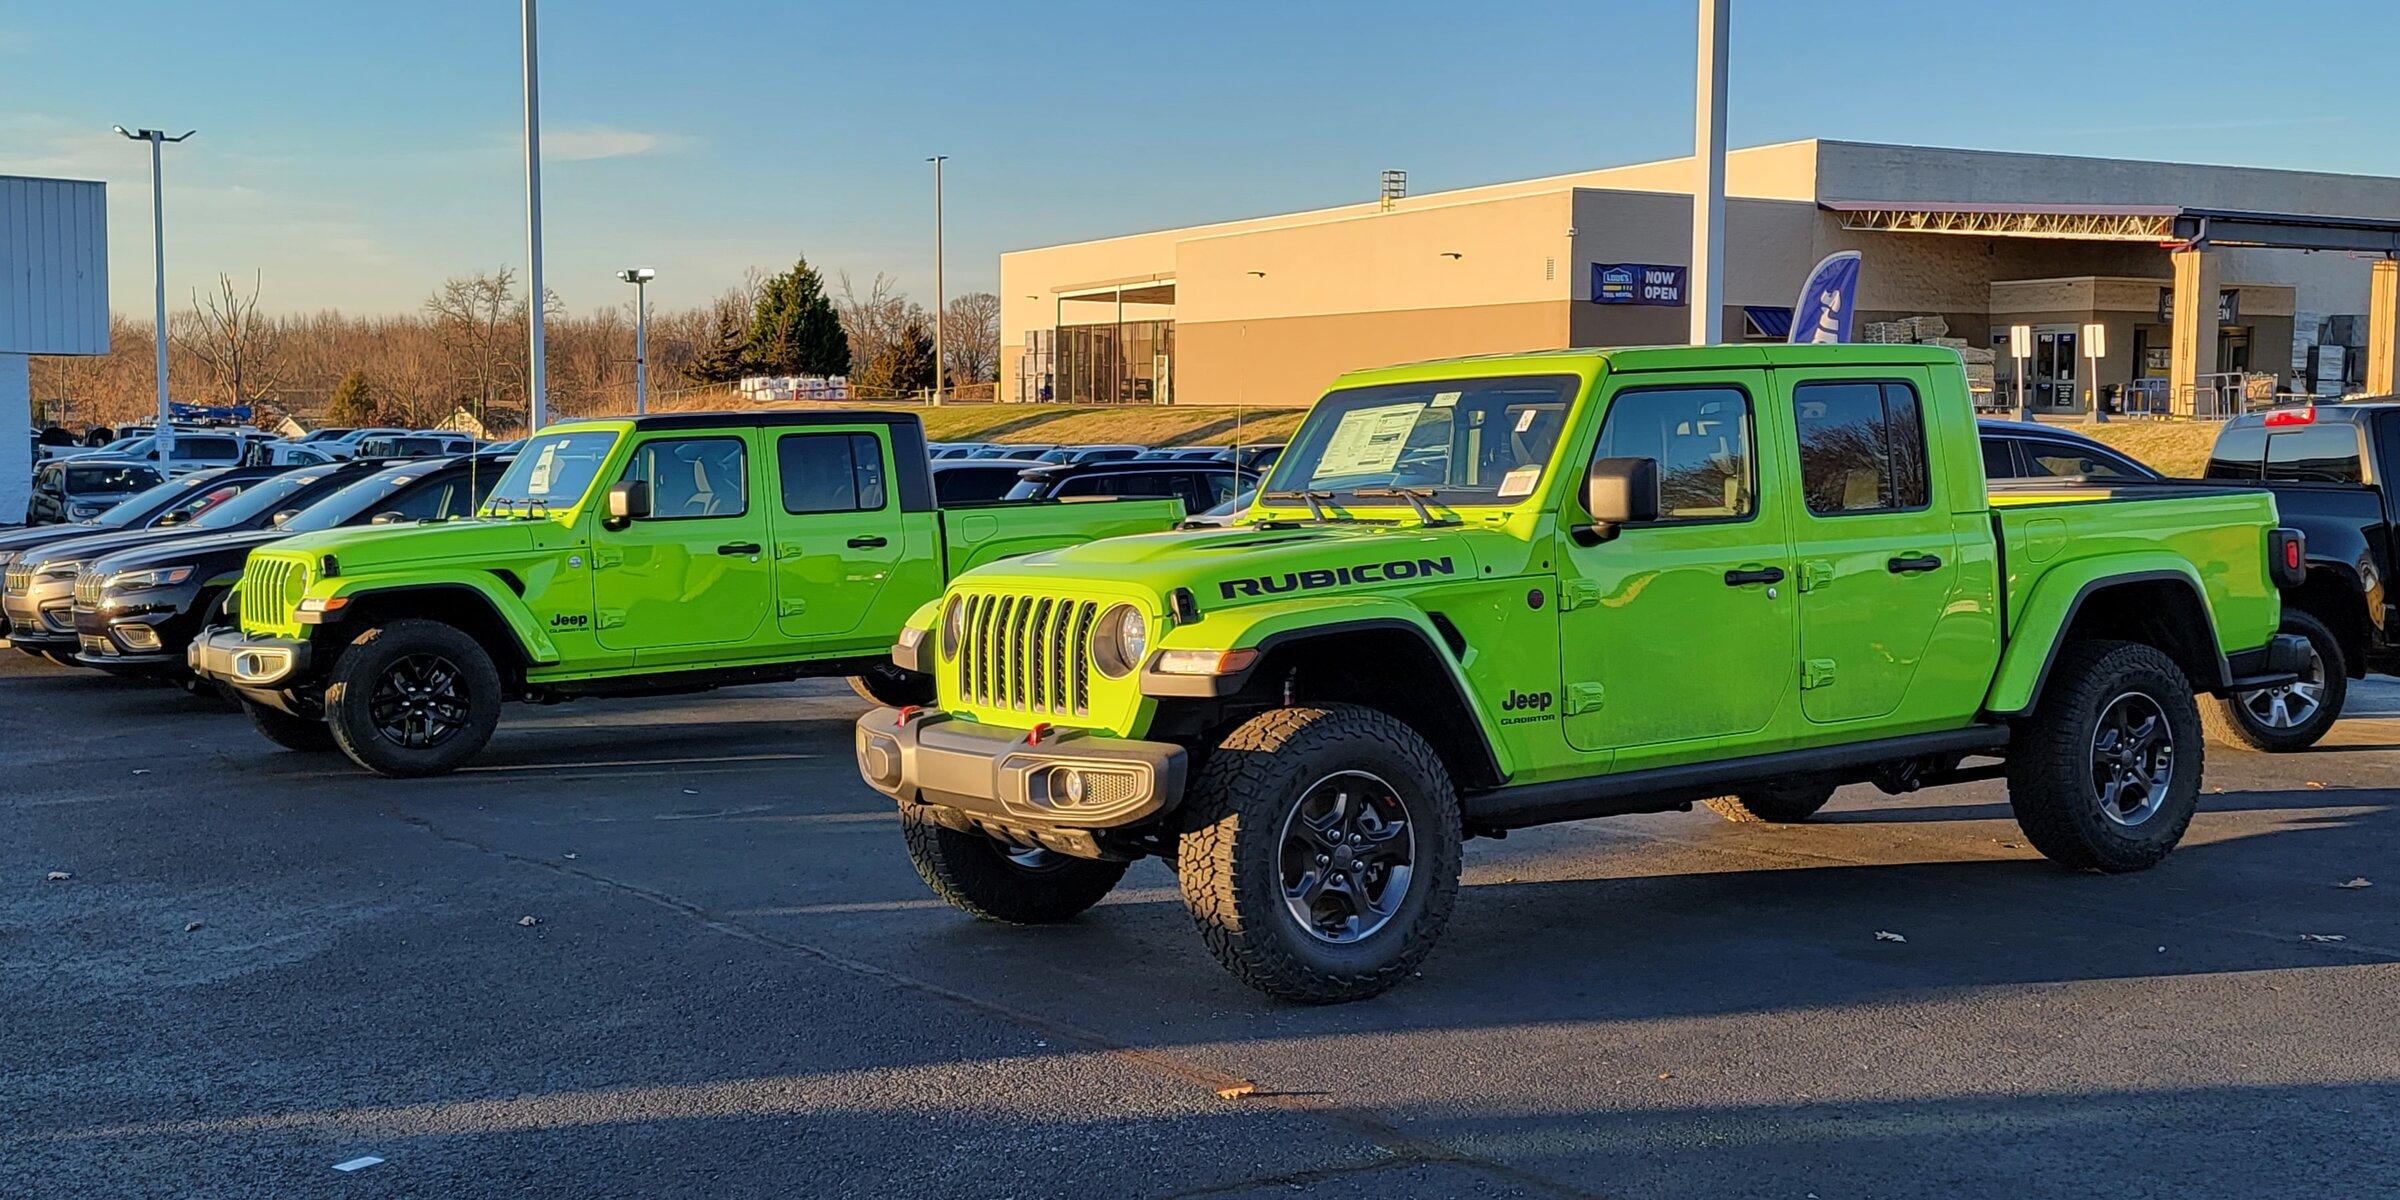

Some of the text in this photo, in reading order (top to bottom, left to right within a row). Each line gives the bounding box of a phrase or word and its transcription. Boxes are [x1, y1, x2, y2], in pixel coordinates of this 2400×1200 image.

[1645, 271, 1675, 284] NOW
[1644, 286, 1678, 300] OPEN
[2041, 334, 2053, 342] PRO
[1218, 556, 1455, 600] RUBICON
[550, 613, 588, 627] Jeep
[1502, 689, 1552, 712] Jeep
[1500, 714, 1555, 726] GLADIATOR
